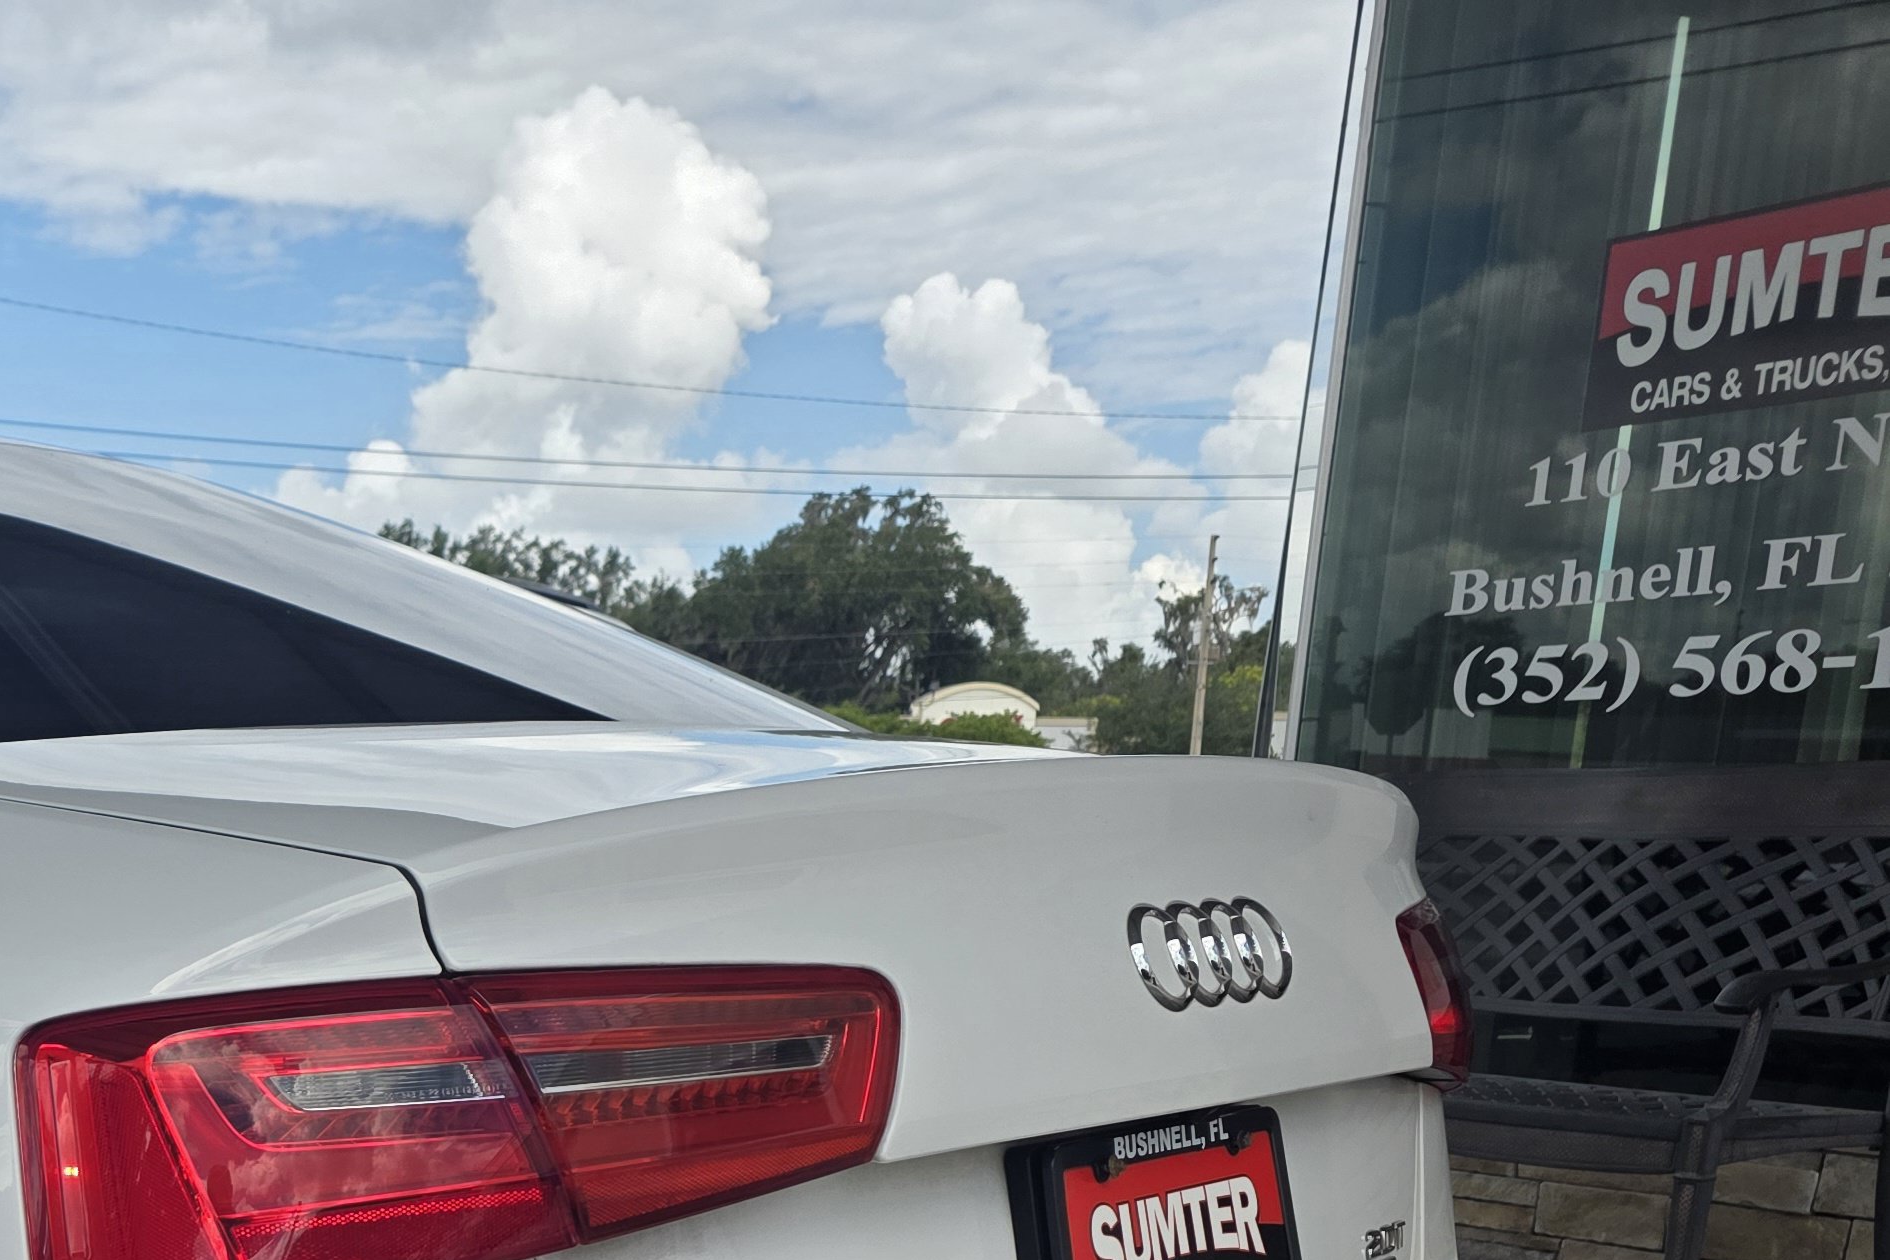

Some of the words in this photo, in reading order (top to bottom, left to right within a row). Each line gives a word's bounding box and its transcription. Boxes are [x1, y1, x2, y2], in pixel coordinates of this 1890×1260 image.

[1630, 372, 1712, 413] CARS
[1720, 367, 1743, 400] &
[1524, 447, 1632, 507] 110
[1651, 427, 1808, 492] East
[1443, 545, 1733, 617] Bushnell,
[1756, 533, 1865, 591] FL
[1453, 635, 1641, 718] (352)
[1113, 1124, 1206, 1159] BUSHNELL,
[1209, 1117, 1229, 1142] FL
